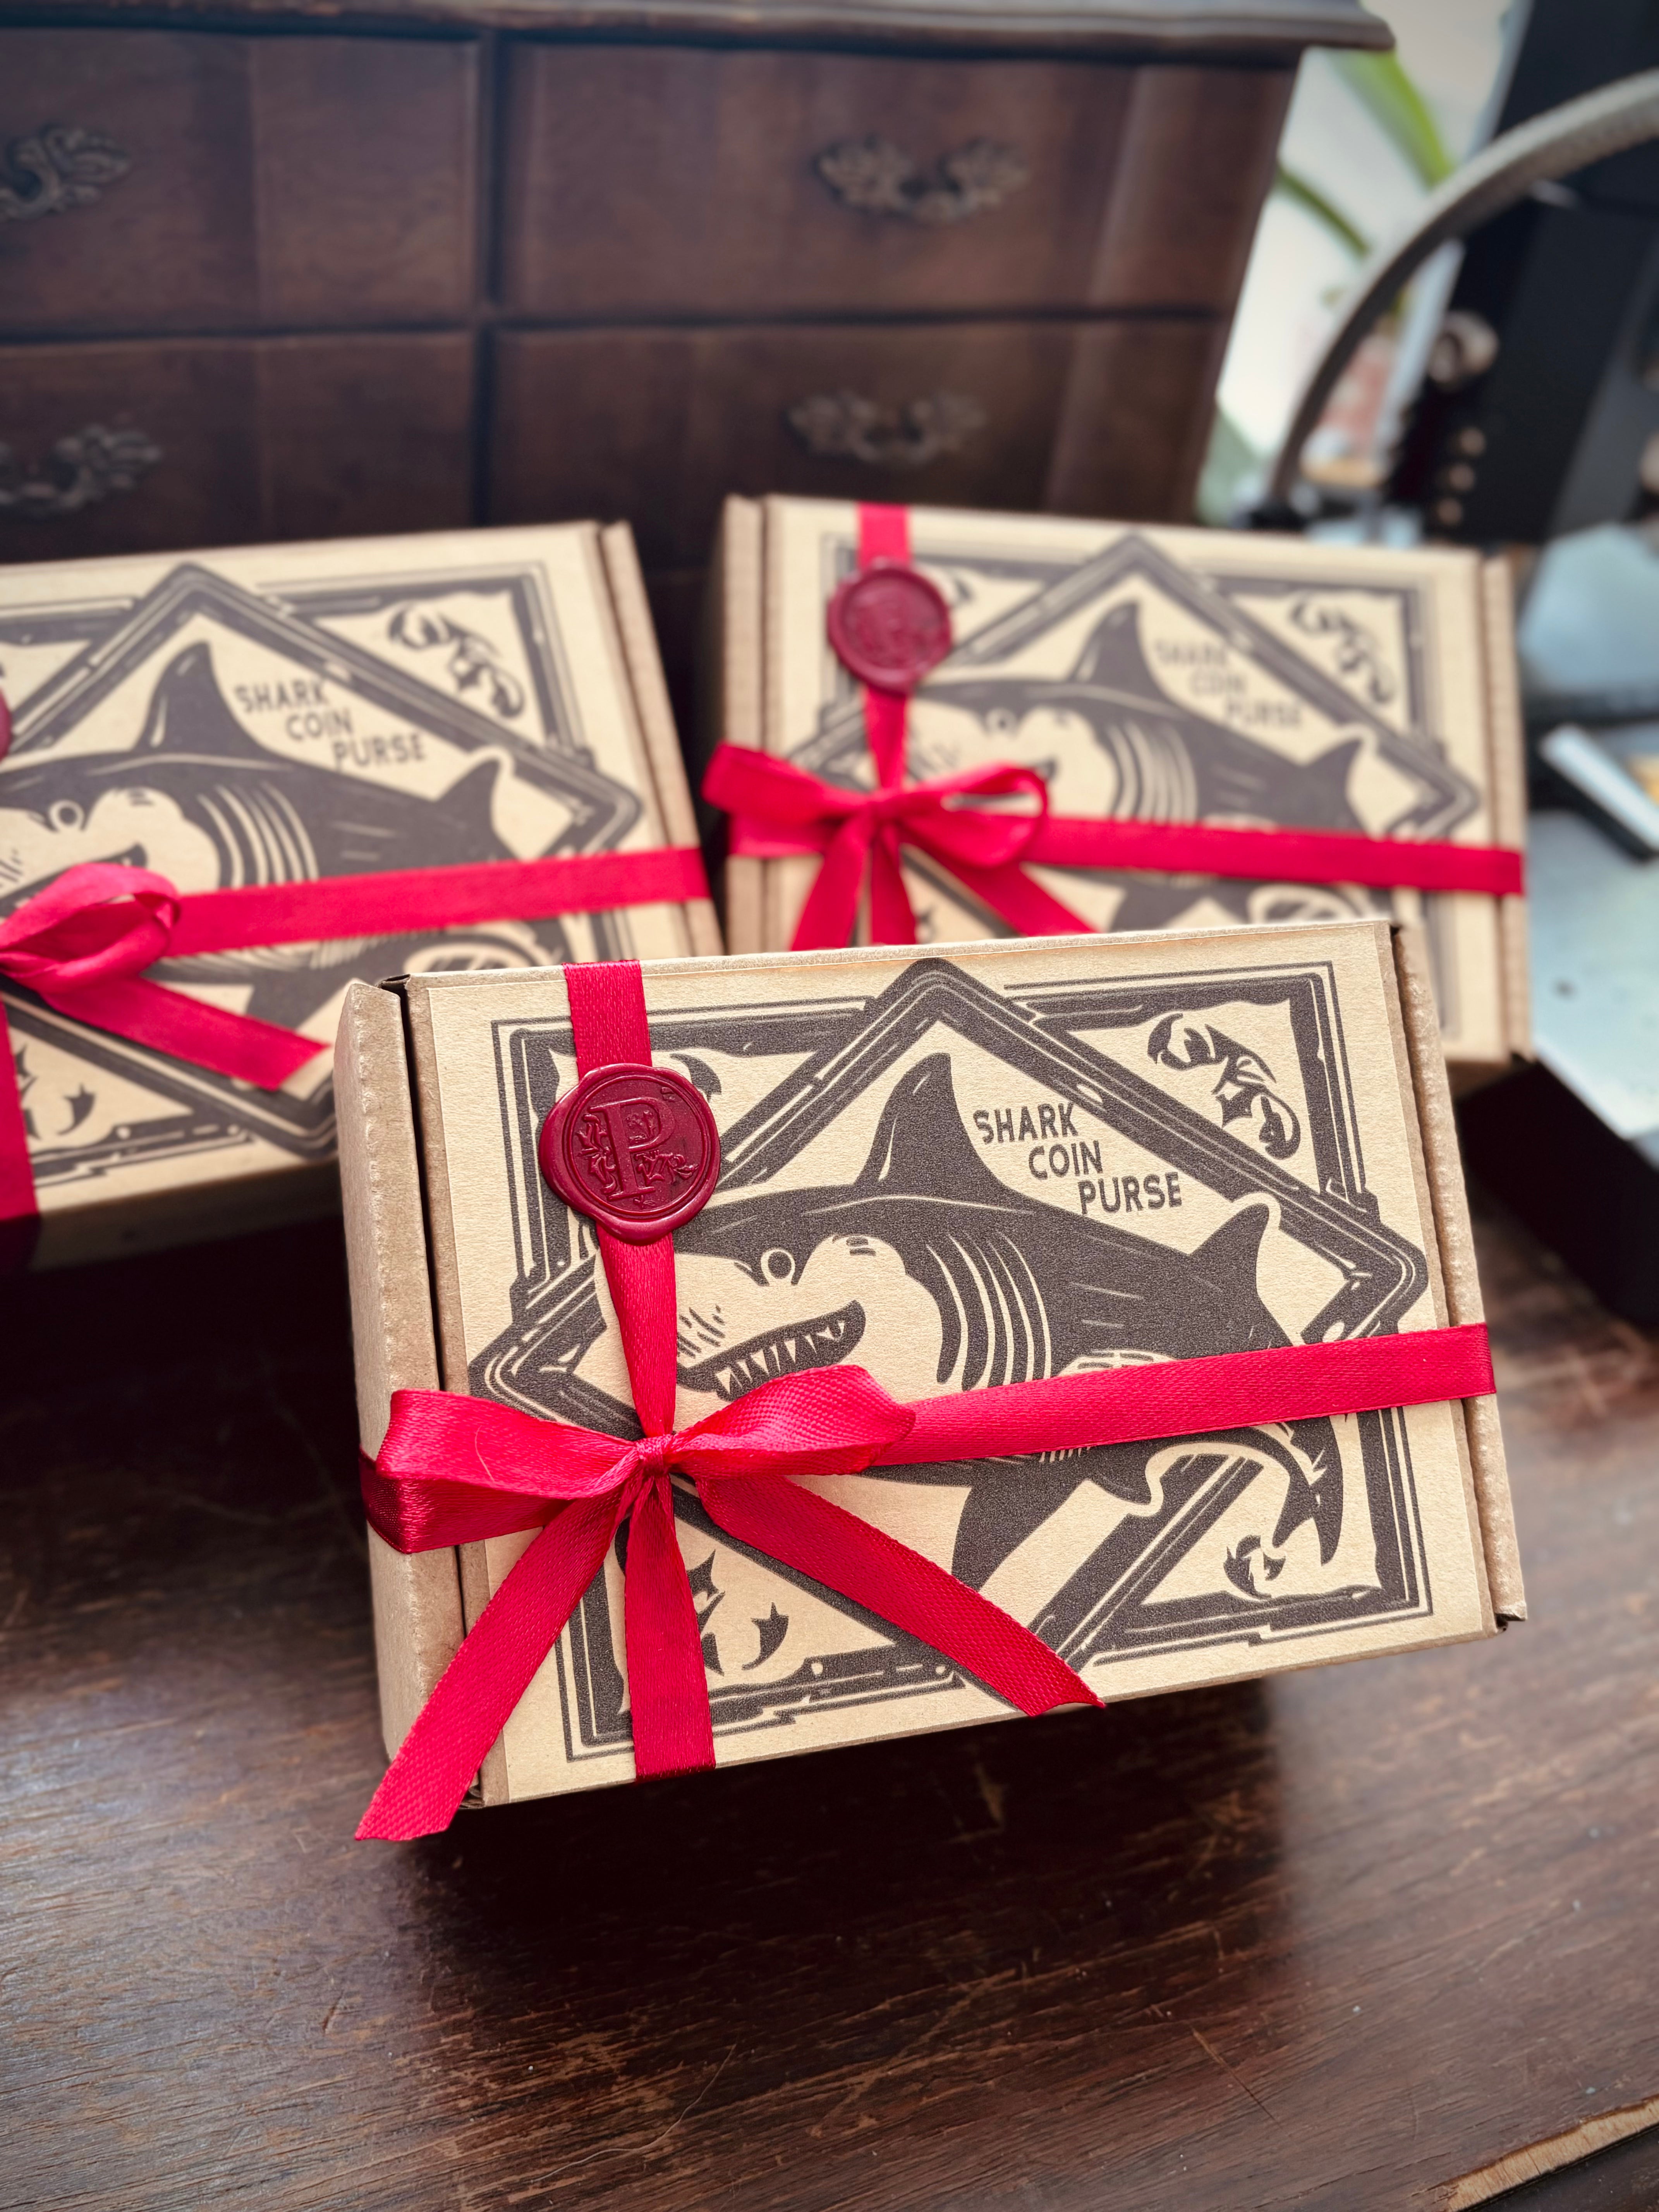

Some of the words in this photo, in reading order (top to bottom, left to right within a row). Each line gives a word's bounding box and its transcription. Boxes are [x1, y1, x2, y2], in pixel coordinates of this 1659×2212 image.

[234, 678, 328, 713] SHARK
[286, 707, 352, 741] COIN
[332, 732, 425, 772] PURSE
[972, 1102, 1078, 1144] SHARK
[589, 1097, 675, 1200] P
[1029, 1140, 1104, 1180] COIN
[1077, 1171, 1182, 1214] PURSE
